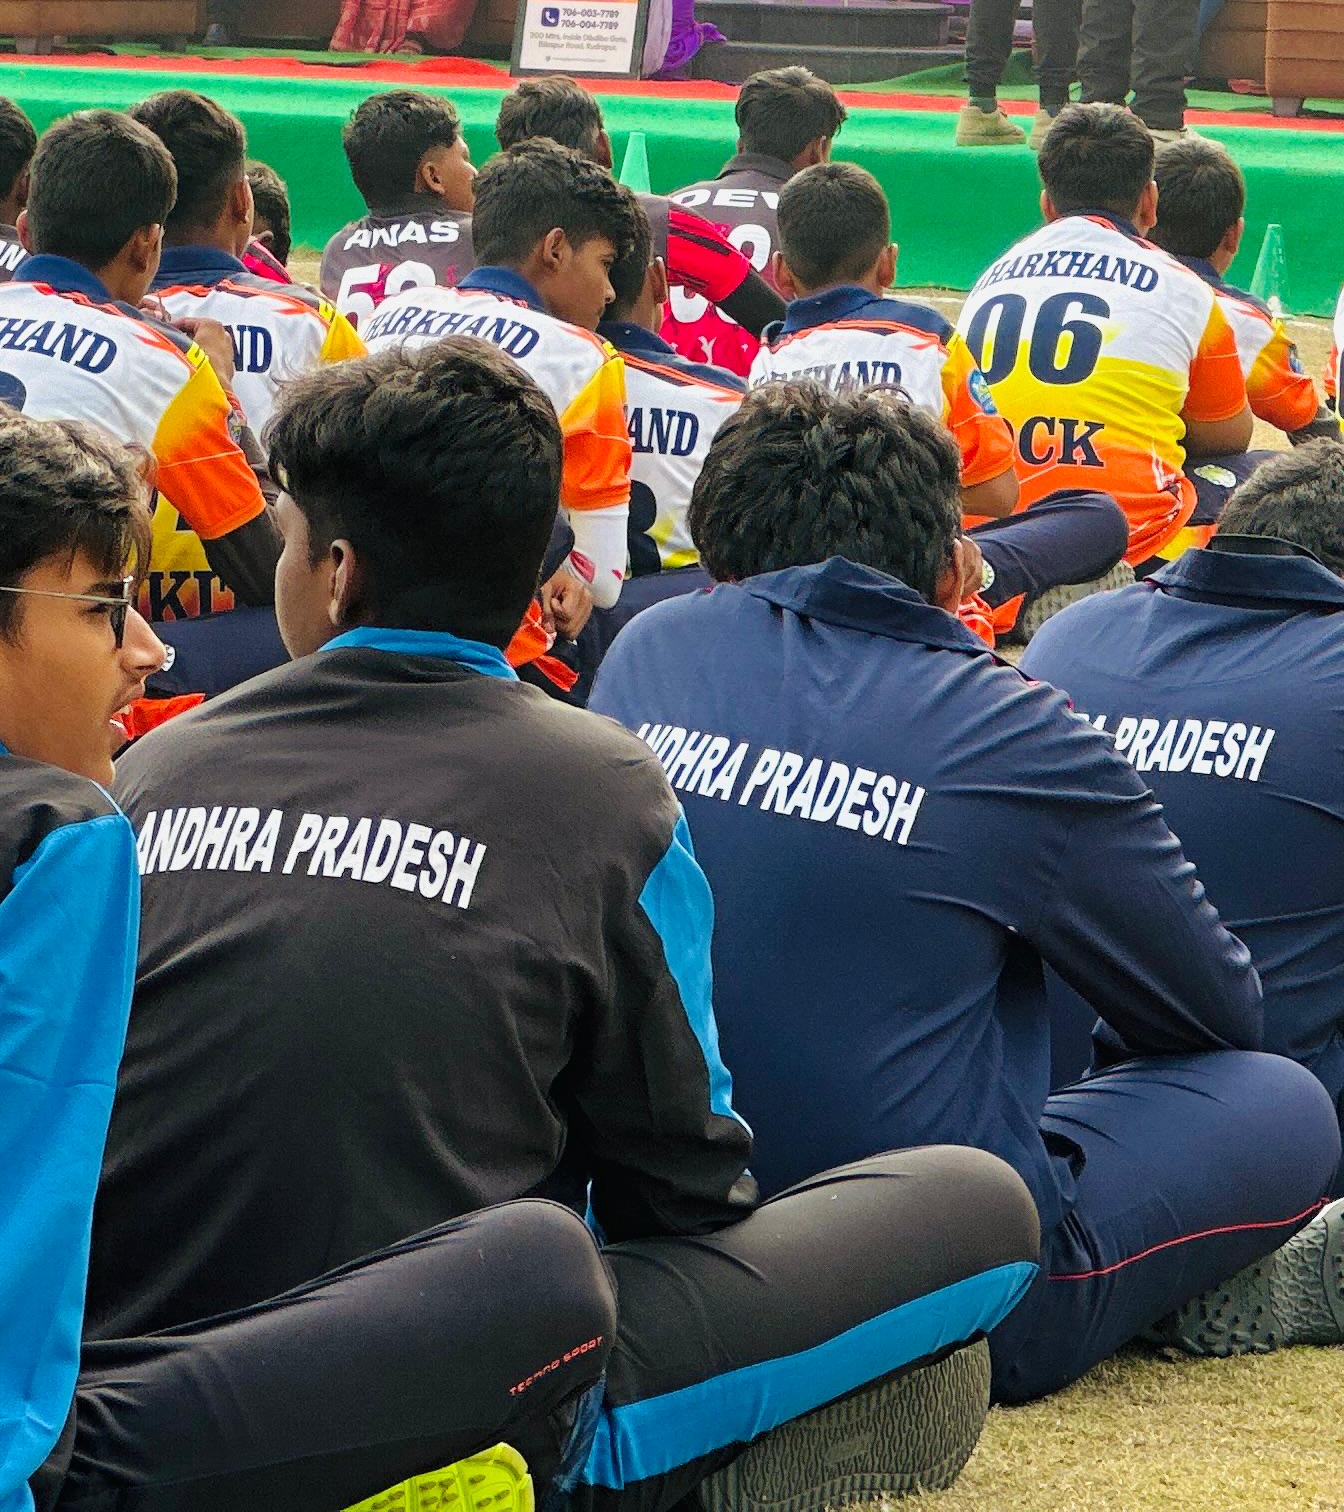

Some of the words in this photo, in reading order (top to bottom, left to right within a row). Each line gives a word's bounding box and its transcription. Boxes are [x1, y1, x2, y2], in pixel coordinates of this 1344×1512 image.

[343, 220, 459, 251] ANAS
[966, 291, 1111, 385] 06
[1114, 714, 1276, 782] PRADESH
[738, 747, 926, 846] PRADESH
[137, 806, 283, 876] ANDHRA
[282, 812, 487, 909] PRADESH
